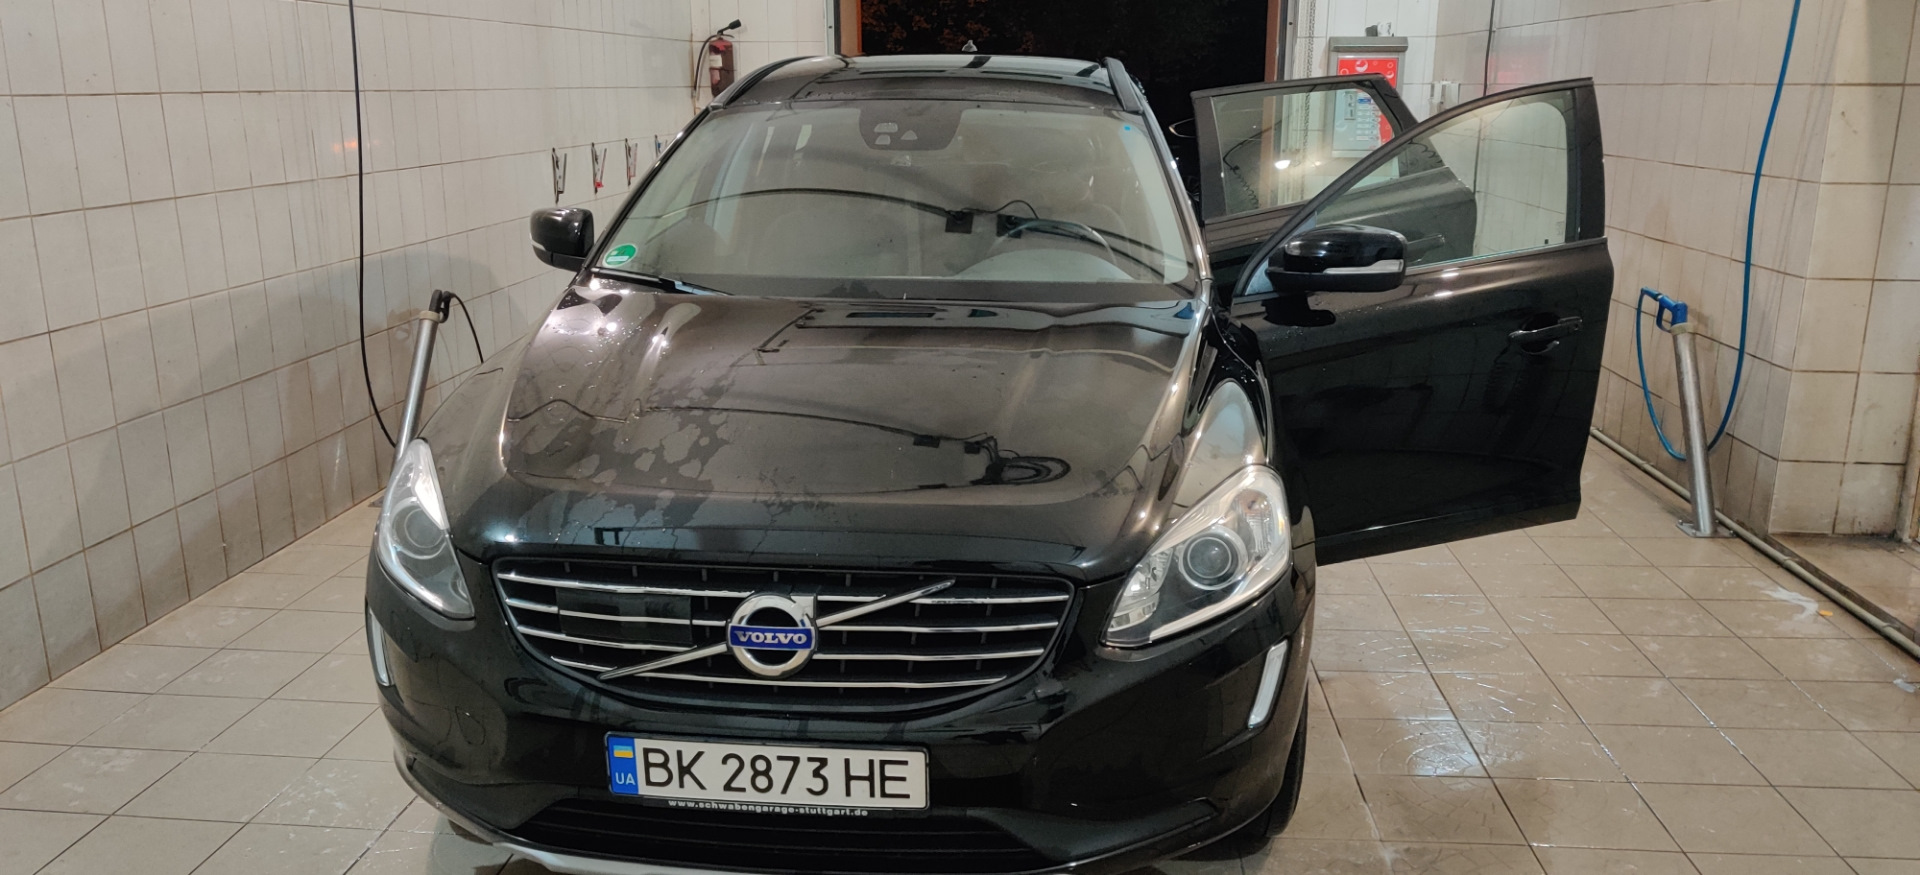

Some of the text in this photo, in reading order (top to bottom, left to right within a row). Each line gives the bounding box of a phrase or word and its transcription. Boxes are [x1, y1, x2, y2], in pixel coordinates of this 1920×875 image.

[734, 630, 807, 645] VOLVO
[615, 772, 636, 786] UA
[642, 747, 911, 799] BK 2873 HE
[668, 799, 868, 817] www.schwabengarage-stuttgart.de
